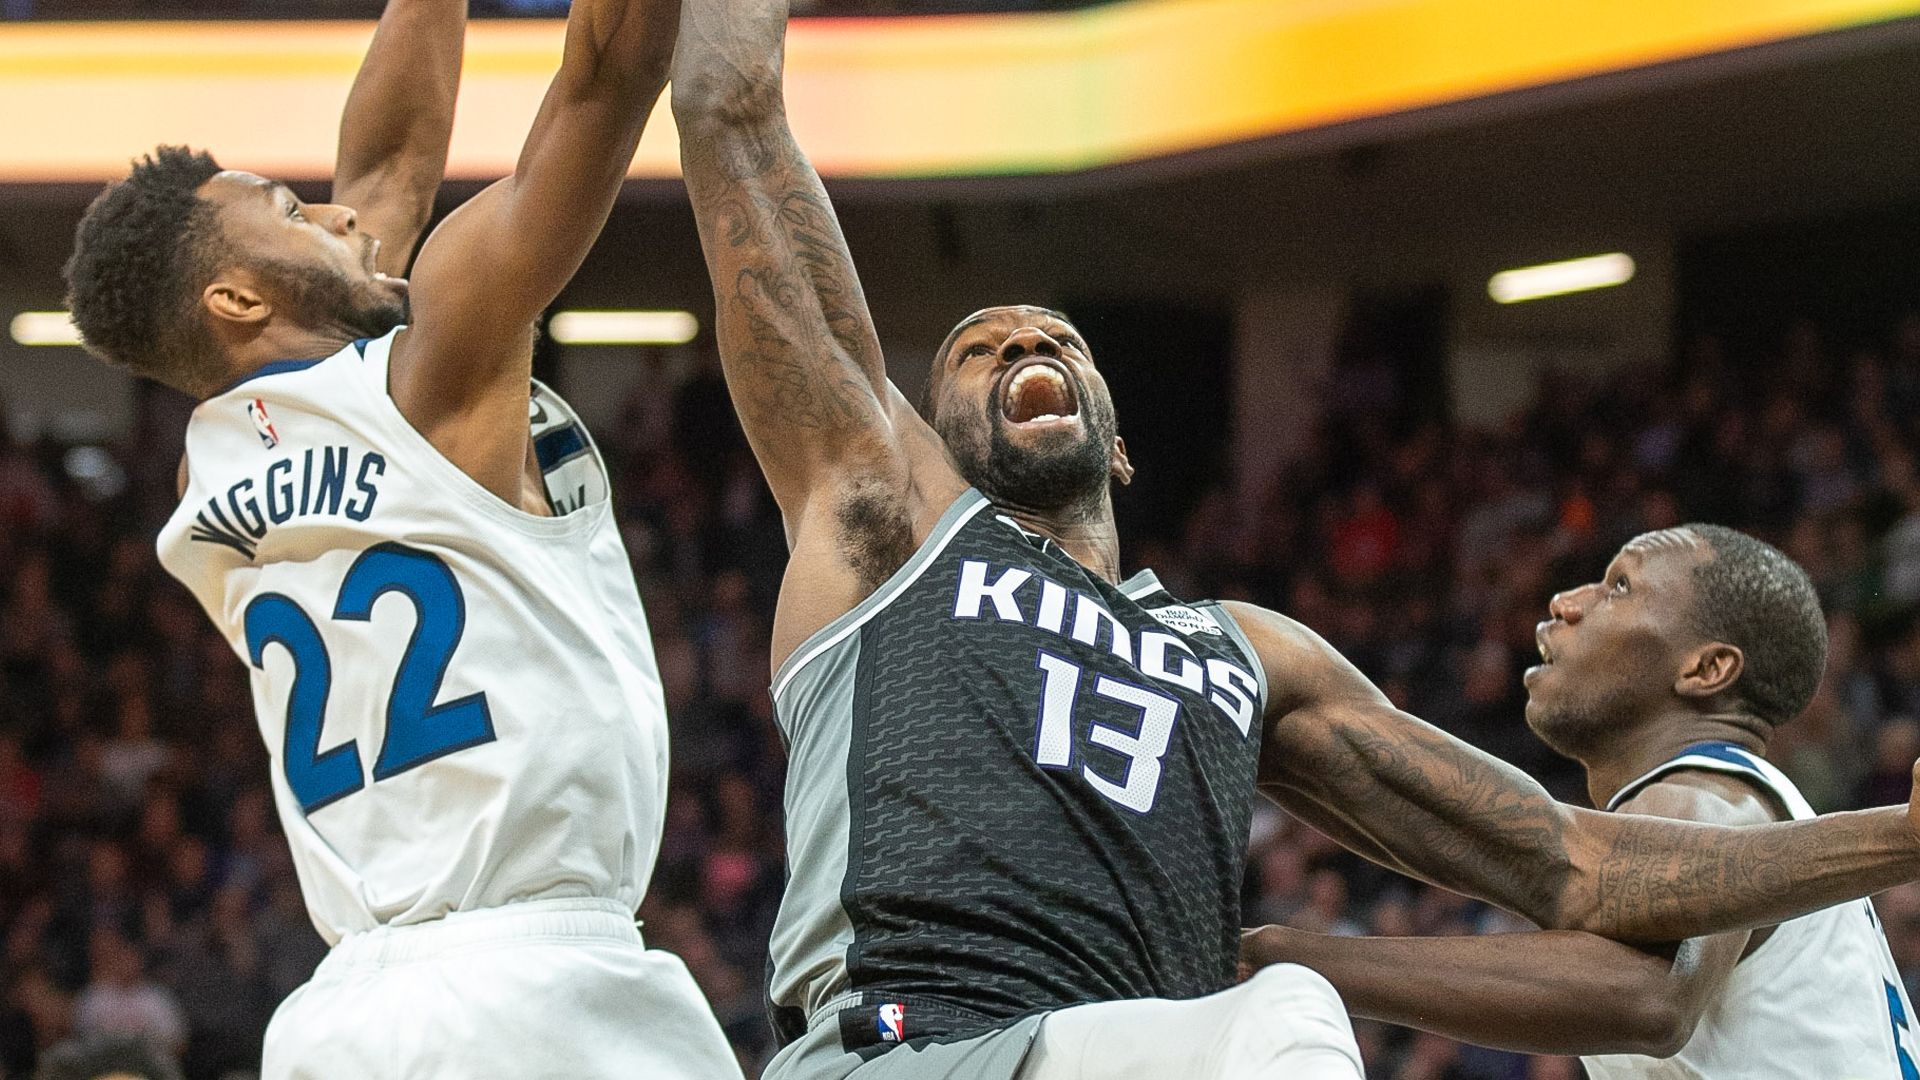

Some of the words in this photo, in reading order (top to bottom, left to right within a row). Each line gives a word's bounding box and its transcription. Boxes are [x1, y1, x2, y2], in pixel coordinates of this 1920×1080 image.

[190, 446, 386, 560] WIGGINS
[244, 540, 498, 816] 22
[951, 557, 1259, 739] KINGS
[1165, 620, 1219, 635] MONDS
[1032, 647, 1182, 815] 13
